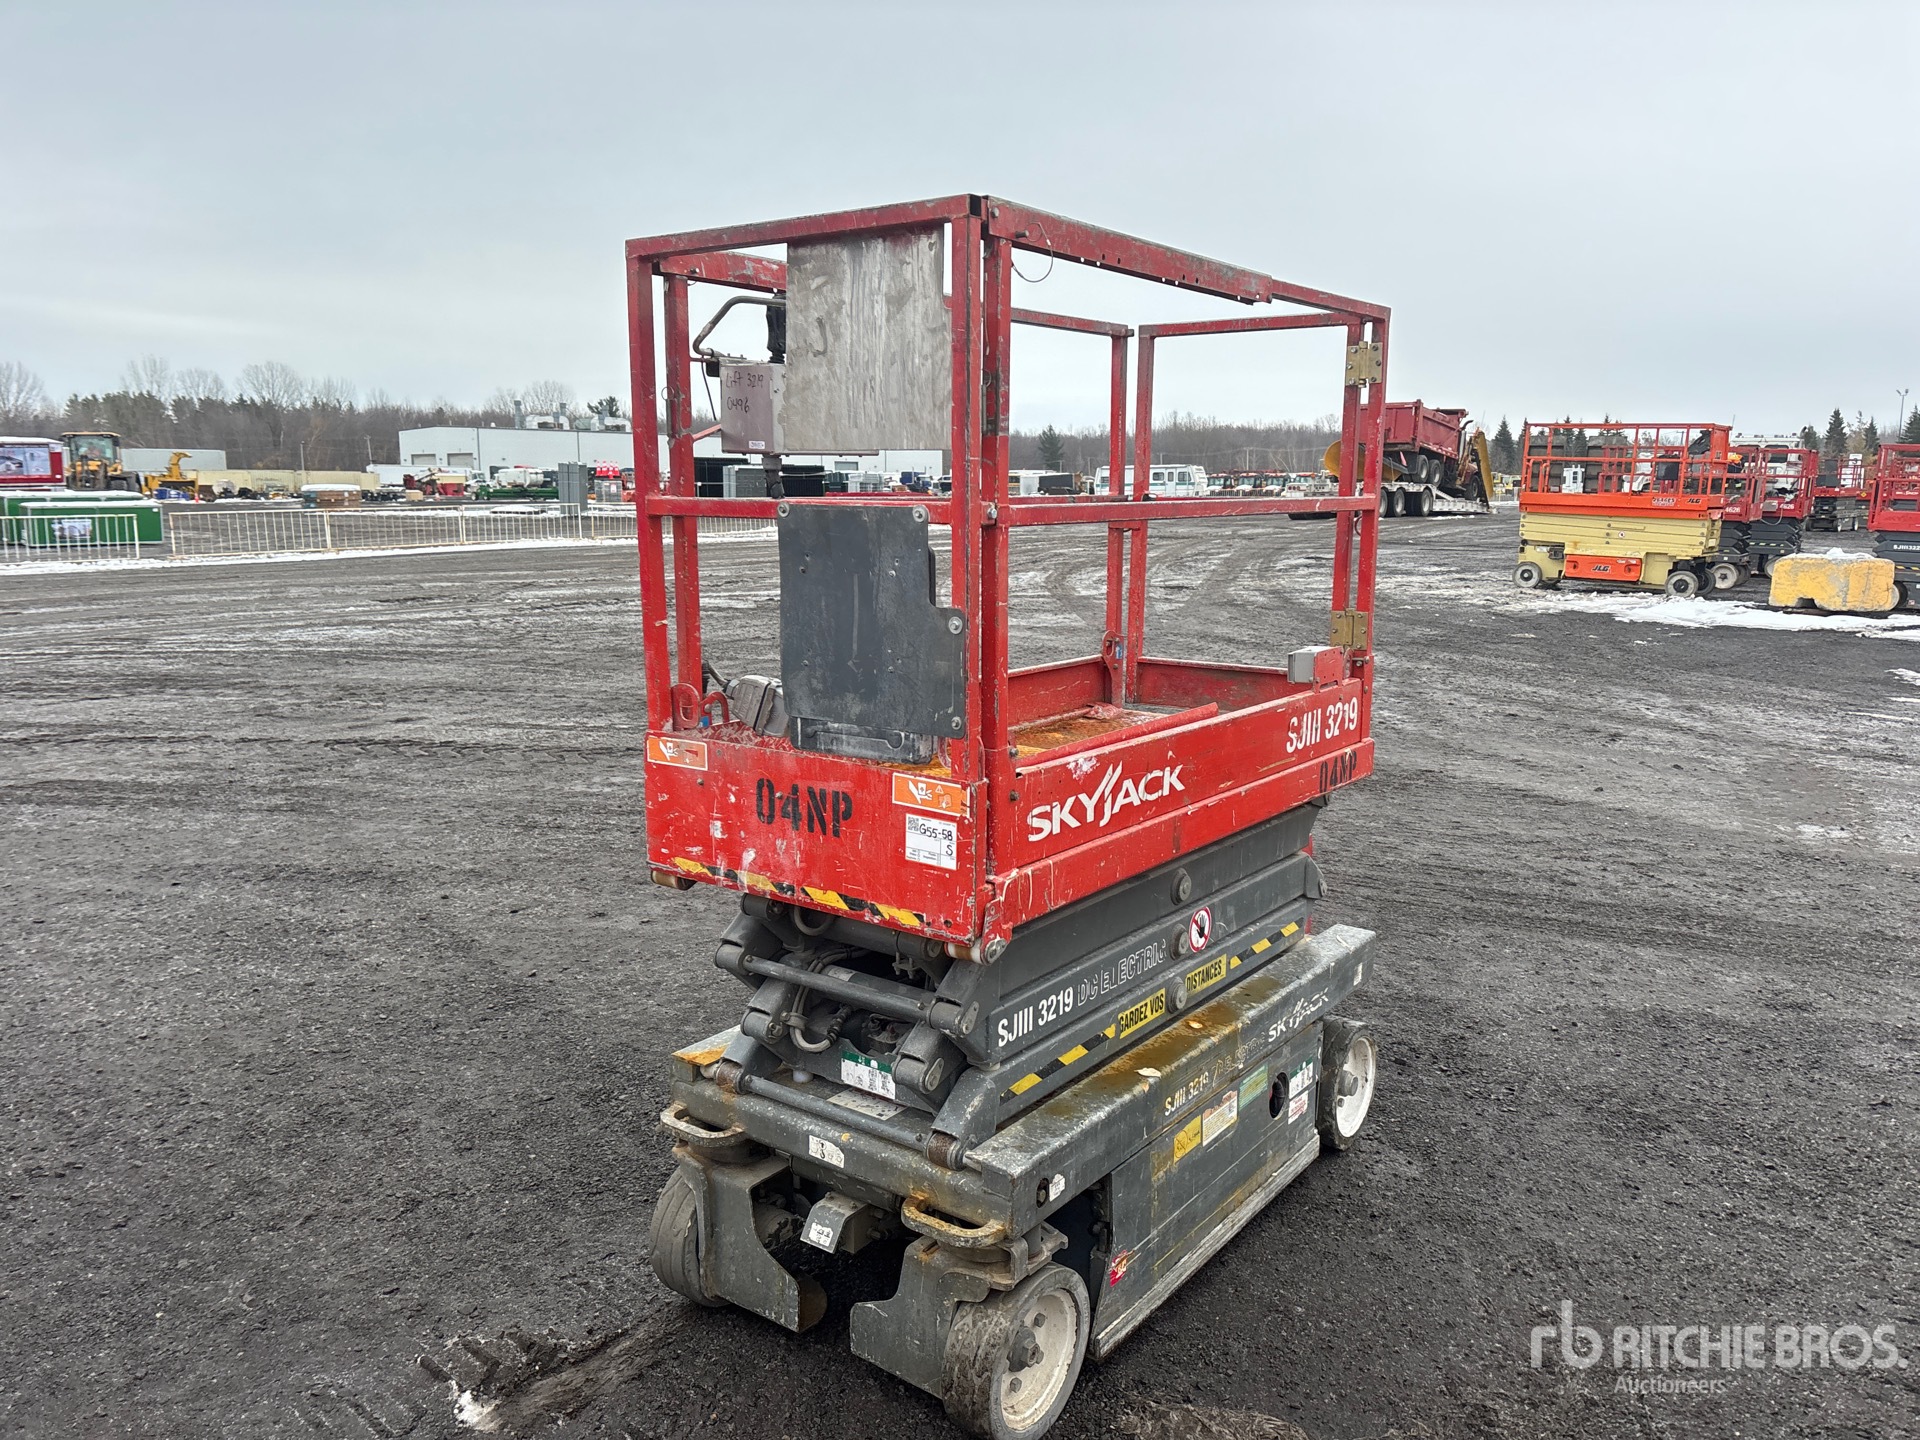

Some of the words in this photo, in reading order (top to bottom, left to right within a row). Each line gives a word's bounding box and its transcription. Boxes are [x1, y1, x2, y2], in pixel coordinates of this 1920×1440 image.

[726, 396, 750, 414] 0496
[1592, 564, 1610, 572] JLG
[1324, 696, 1359, 740] 3219
[755, 778, 853, 838] 04NP
[1027, 760, 1186, 842] SKYJACK
[919, 823, 953, 842] G55-58
[998, 1005, 1035, 1048] SJIII
[1038, 986, 1074, 1027] 3219
[1101, 938, 1168, 995] ELECTRIC
[1186, 959, 1223, 991] DISTANCES
[1118, 1001, 1149, 1034] GARDEZ
[1149, 993, 1165, 1017] VOS
[1267, 987, 1329, 1043] SKYJACK
